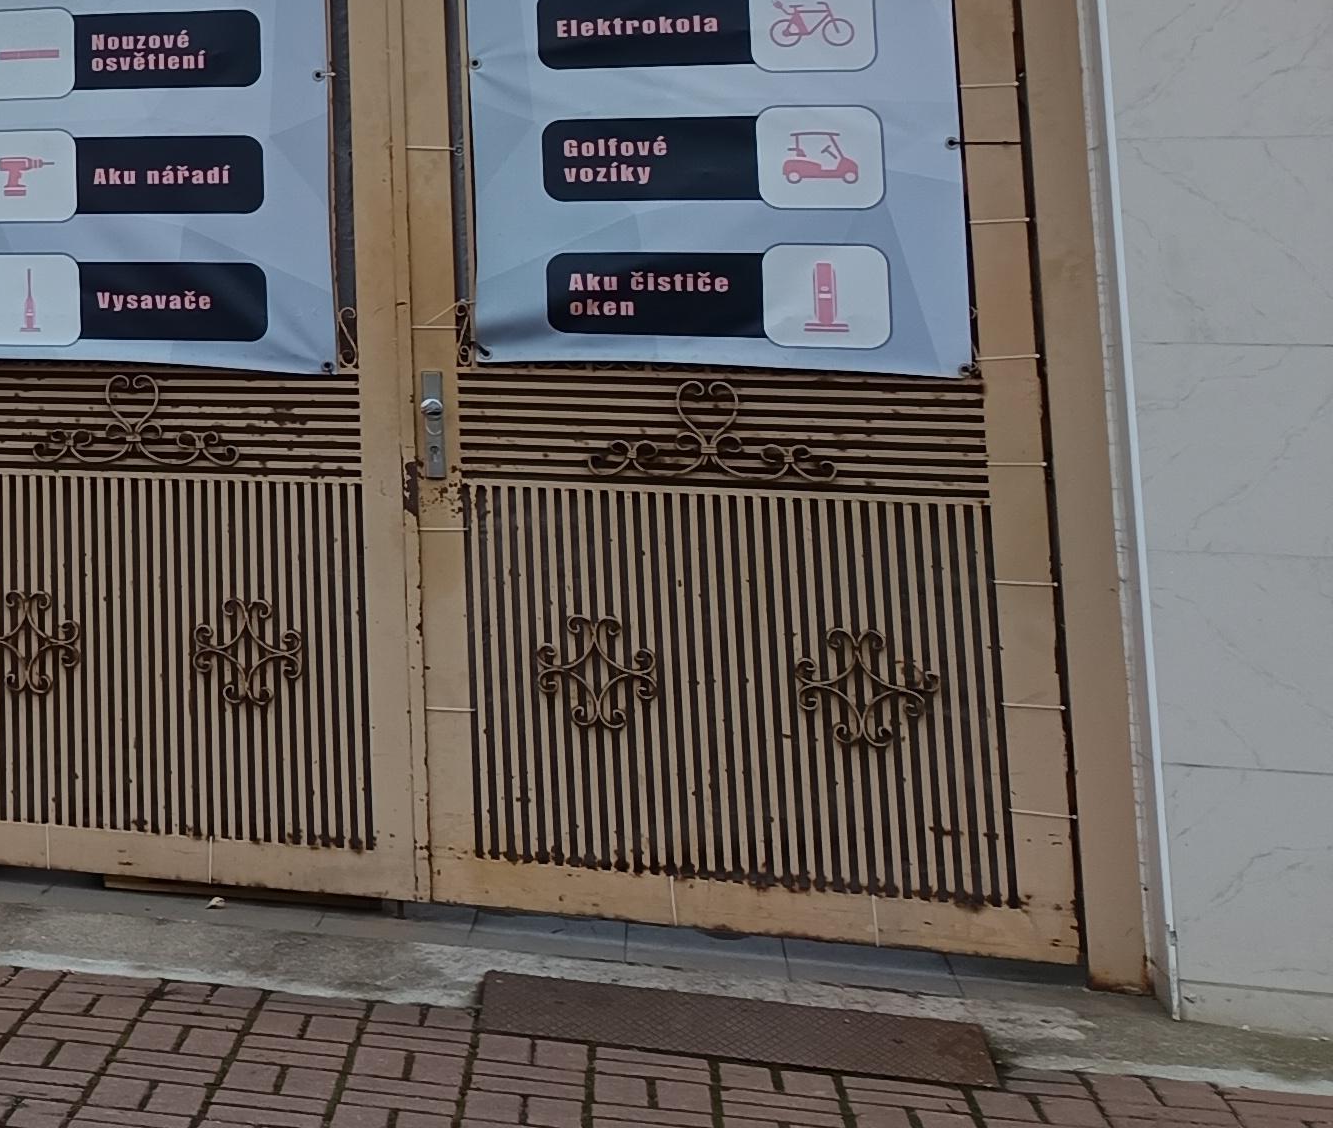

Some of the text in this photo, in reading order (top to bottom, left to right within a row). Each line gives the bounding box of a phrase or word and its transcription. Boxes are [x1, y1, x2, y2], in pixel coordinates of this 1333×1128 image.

[555, 13, 719, 39] Elektrokola
[91, 29, 190, 52] Nouzové
[91, 50, 206, 72] osvětlení
[563, 135, 668, 158] Golfové
[92, 164, 231, 186] Aku nářadí
[563, 161, 651, 185] vozíky
[568, 272, 730, 293] Aku čističe
[96, 290, 212, 312] Vysavače
[569, 299, 635, 317] oken
